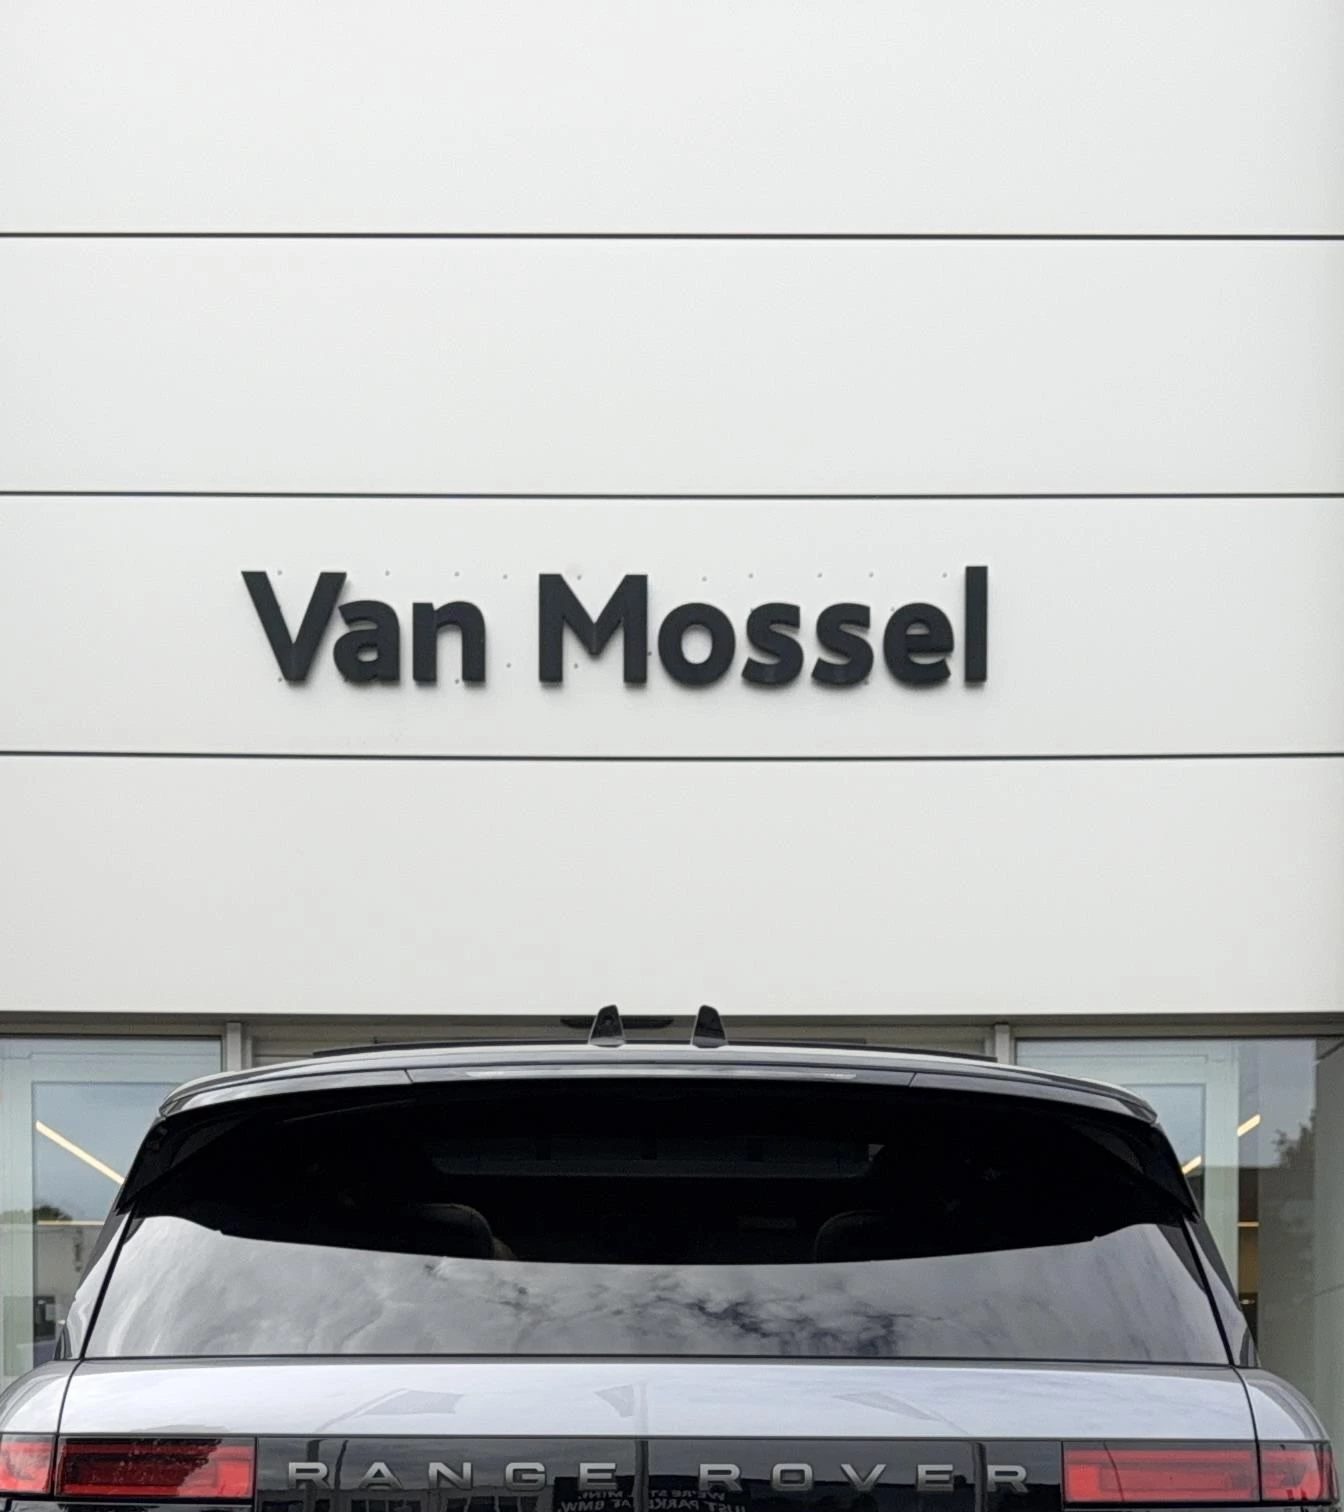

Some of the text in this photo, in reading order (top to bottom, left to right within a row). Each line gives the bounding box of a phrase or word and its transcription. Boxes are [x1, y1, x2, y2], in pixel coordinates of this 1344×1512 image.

[241, 565, 989, 689] Van Mossel
[288, 1461, 1030, 1494] RANGE ROVER
